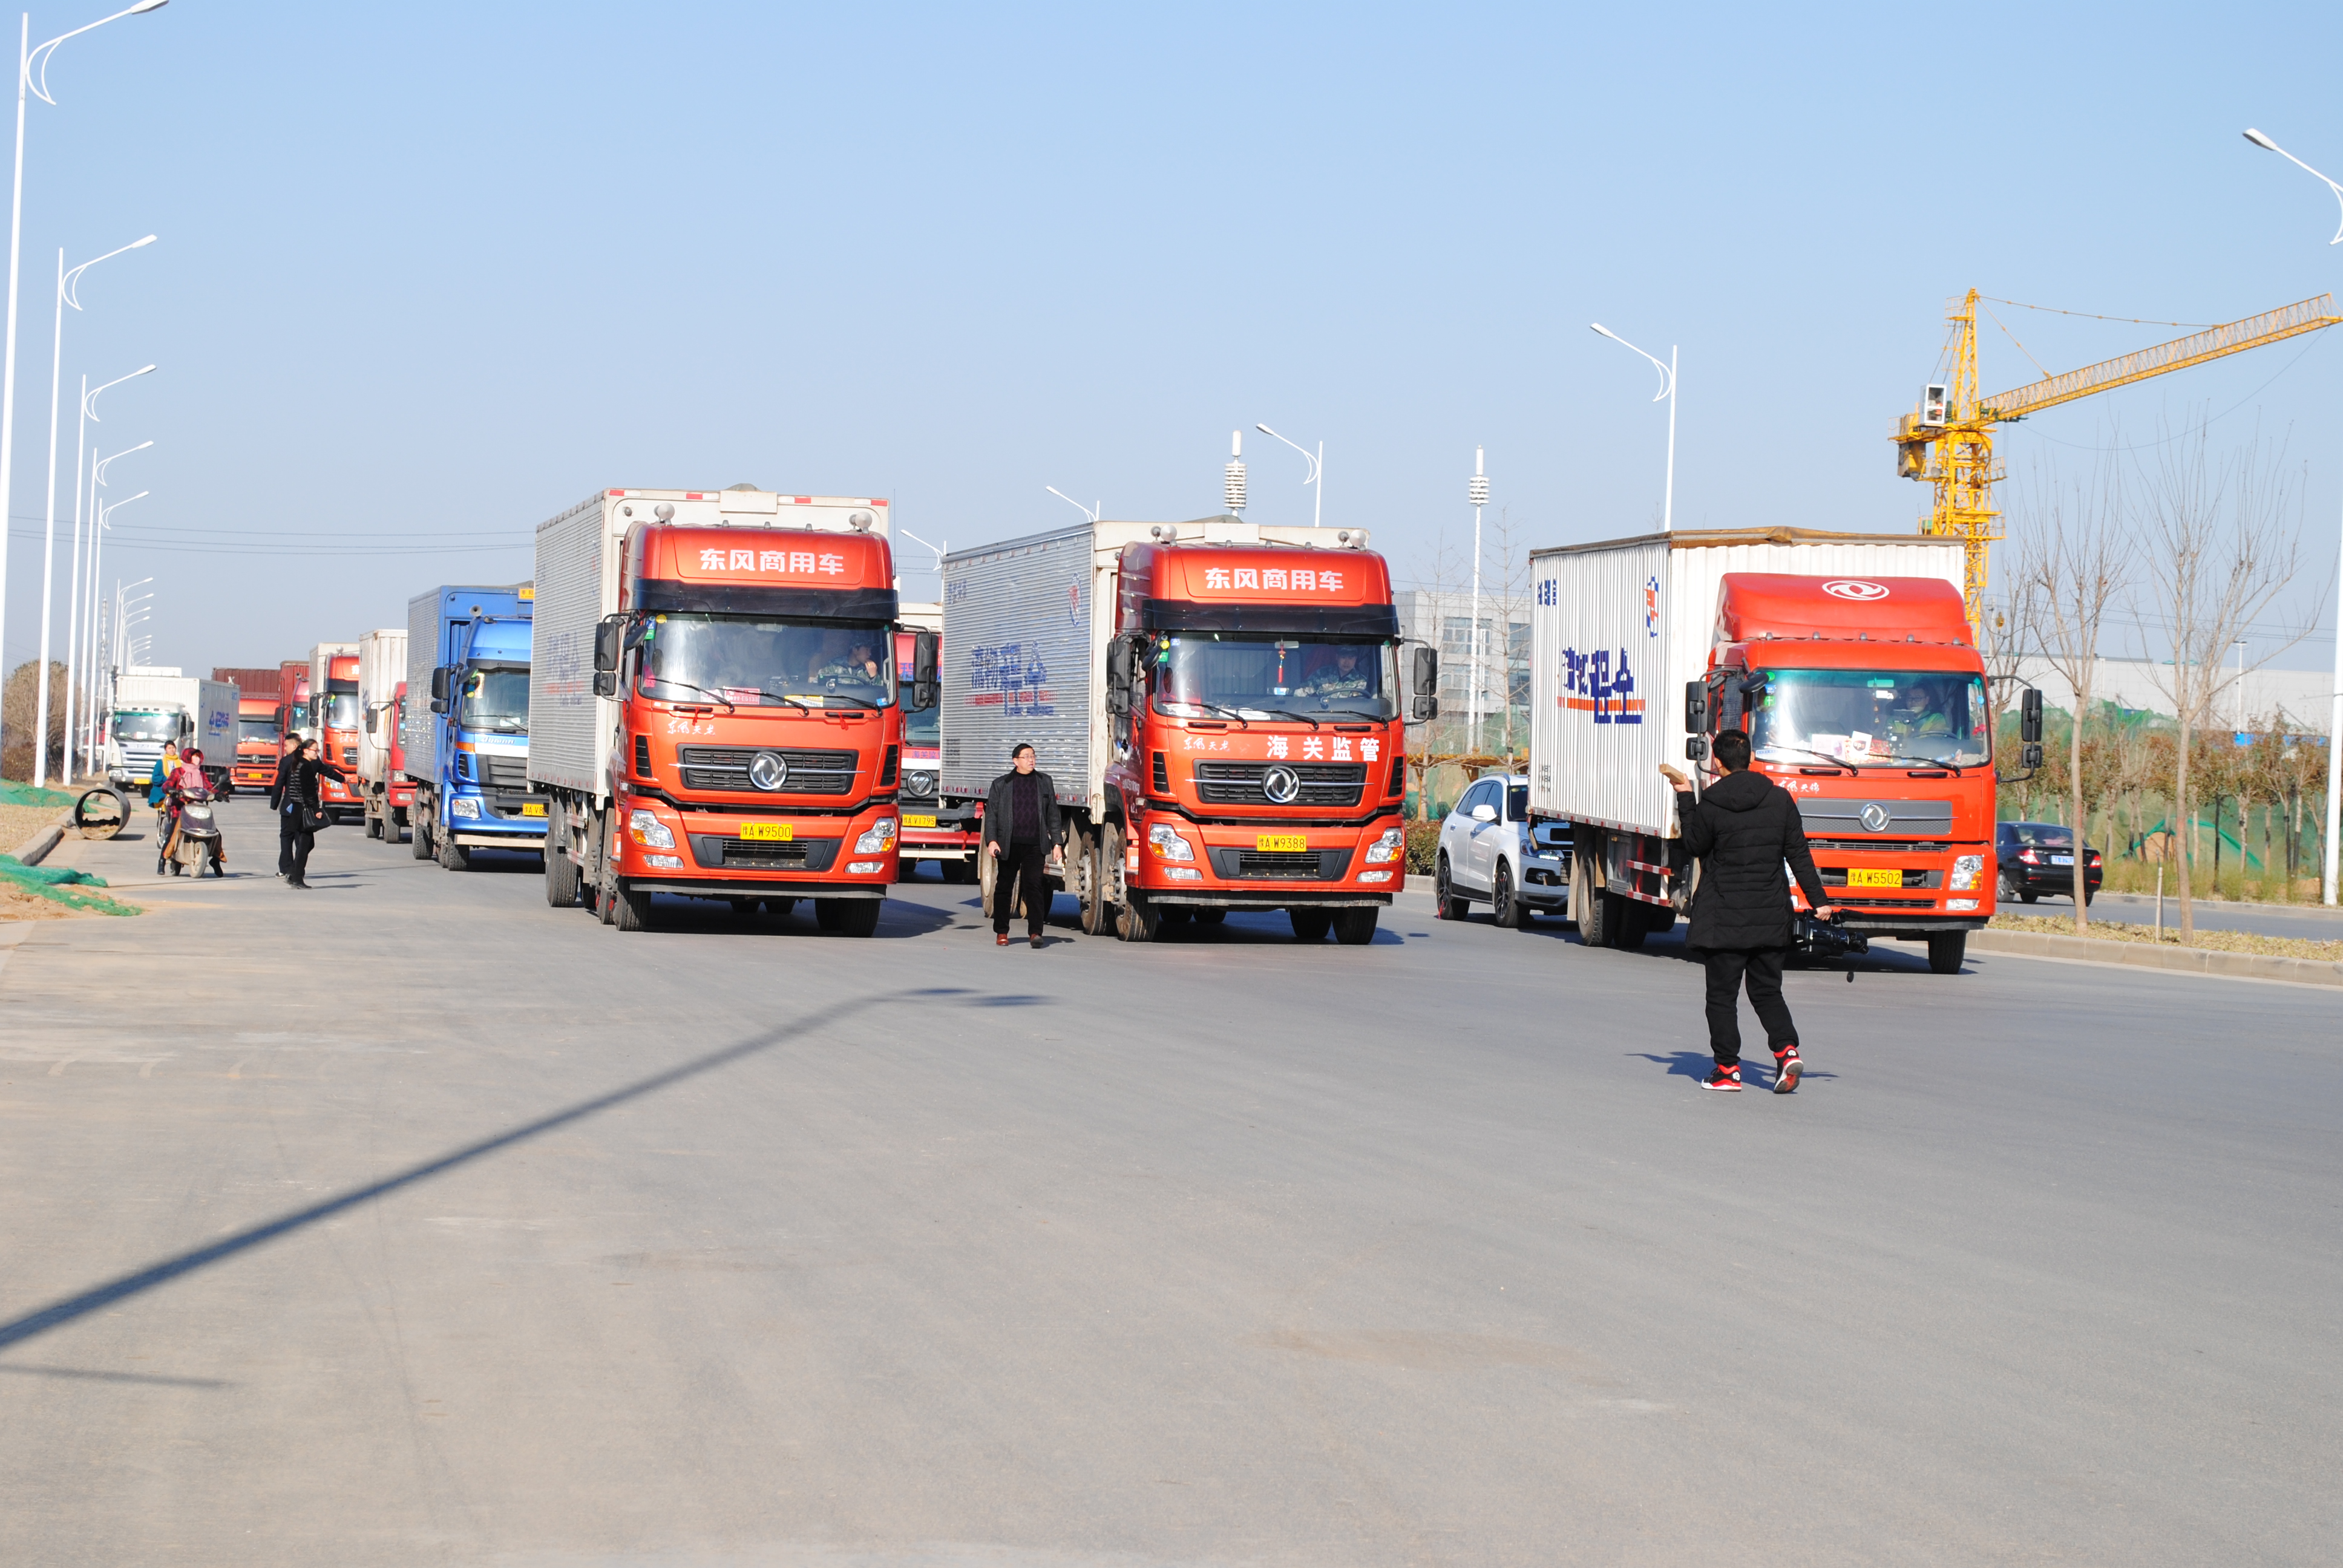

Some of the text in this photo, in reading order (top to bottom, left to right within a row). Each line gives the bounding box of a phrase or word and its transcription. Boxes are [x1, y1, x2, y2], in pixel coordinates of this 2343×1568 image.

[700, 548, 844, 575] 东风商用车
[1205, 567, 1344, 592] 东风商用车
[1267, 735, 1380, 762] 海关监管
